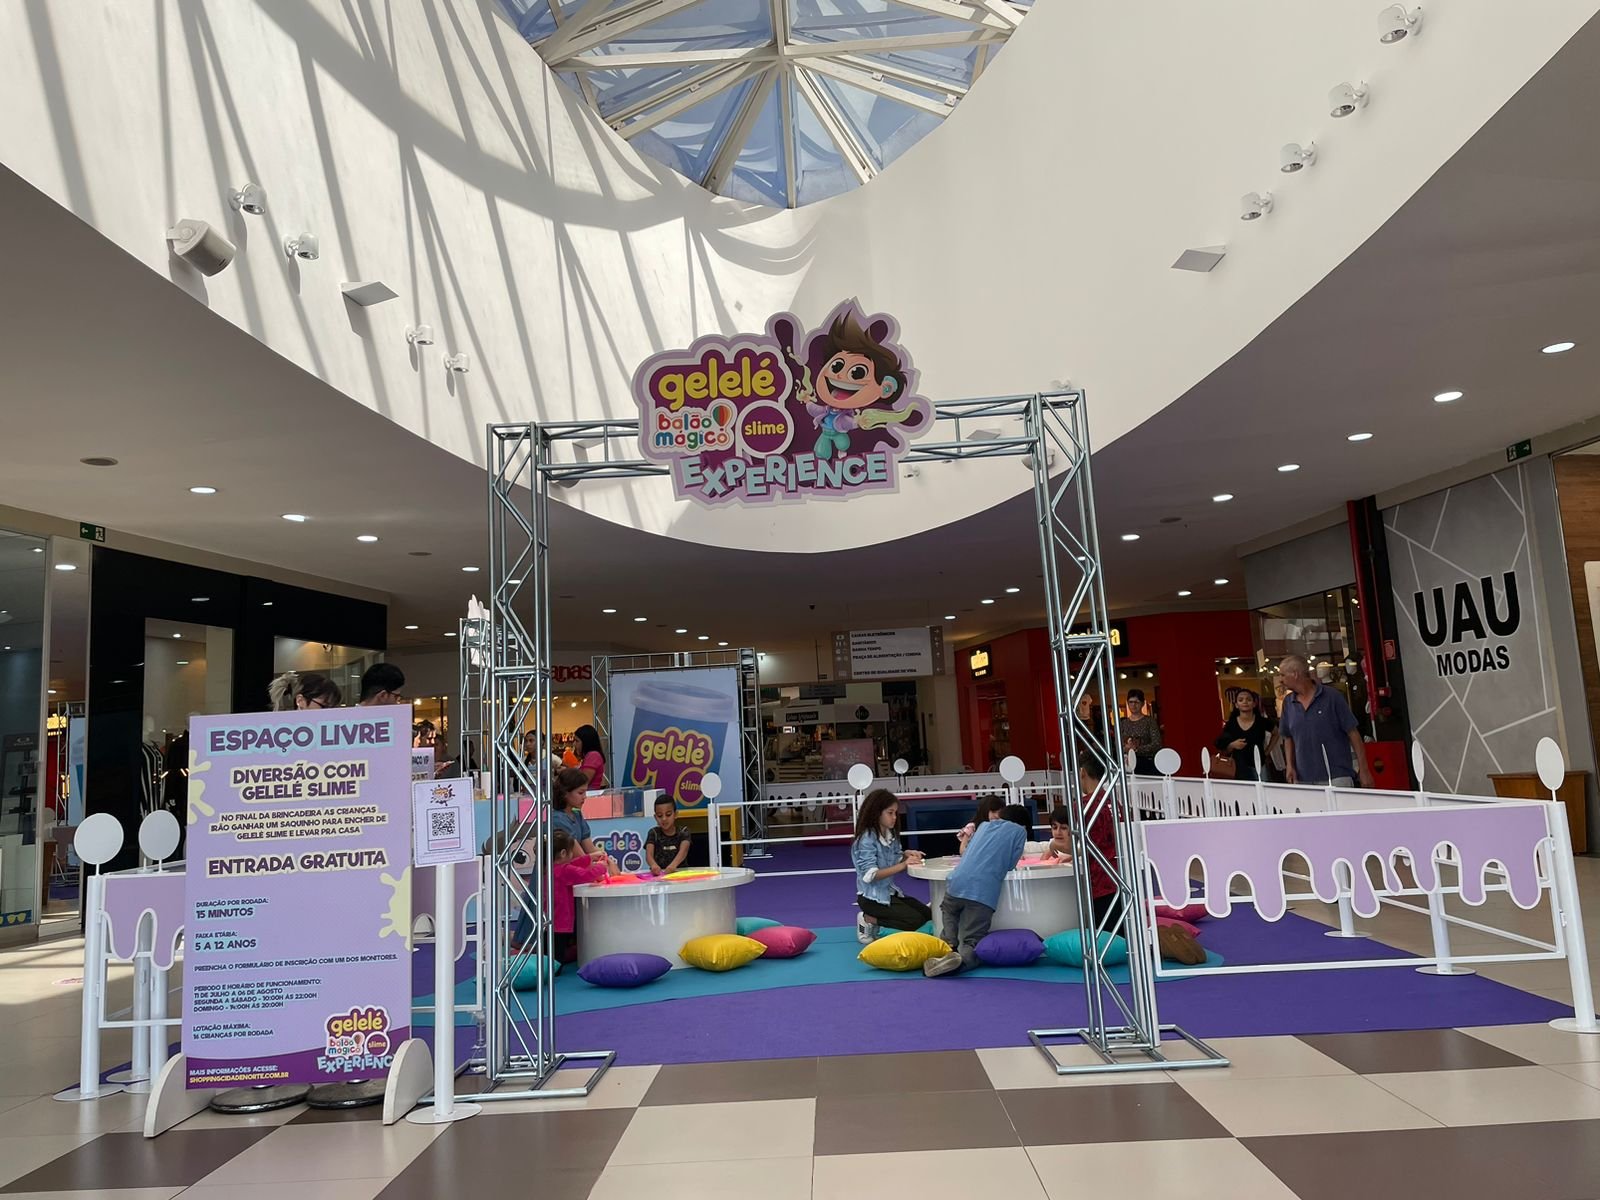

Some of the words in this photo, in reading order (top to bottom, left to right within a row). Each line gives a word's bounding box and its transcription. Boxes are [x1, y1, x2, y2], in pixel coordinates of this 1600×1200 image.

[658, 356, 776, 411] gelelé
[657, 412, 712, 431] balão
[744, 420, 785, 436] slime
[655, 428, 728, 449] mágico
[679, 452, 887, 496] EXPERIENCE
[1414, 571, 1520, 647] UAU
[1436, 646, 1510, 676] MODAS
[210, 726, 314, 753] ESPAÇO
[320, 721, 390, 746] LIVRE
[640, 735, 704, 765] gelelé
[233, 763, 319, 784] DIVERSÃO
[324, 763, 366, 779] COM
[242, 781, 302, 800] GELELÉ
[307, 780, 357, 797] SLIME
[272, 810, 322, 819] BRINCADEIRA
[336, 806, 376, 816] CRIANÇAS
[210, 823, 230, 832] IRÃO
[231, 822, 264, 830] GANHAR
[280, 819, 320, 828] SAQUINHO
[344, 816, 374, 824] ENCHER
[236, 830, 264, 840] GELELÉ
[208, 855, 295, 875] ENTRADA
[300, 850, 387, 870] GRATUITA
[196, 910, 206, 919] 15
[208, 908, 253, 918] MINUTOS
[195, 942, 201, 951] 5
[214, 941, 224, 949] 12
[227, 939, 256, 948] ANOS
[285, 958, 317, 966] INSCRIÇÃO
[266, 979, 321, 987] FUNCIONAMENTO:
[331, 1011, 382, 1037] gelelé
[207, 1066, 251, 1075] INFORMAÇÕES
[317, 1054, 394, 1073] EXPERIENC
